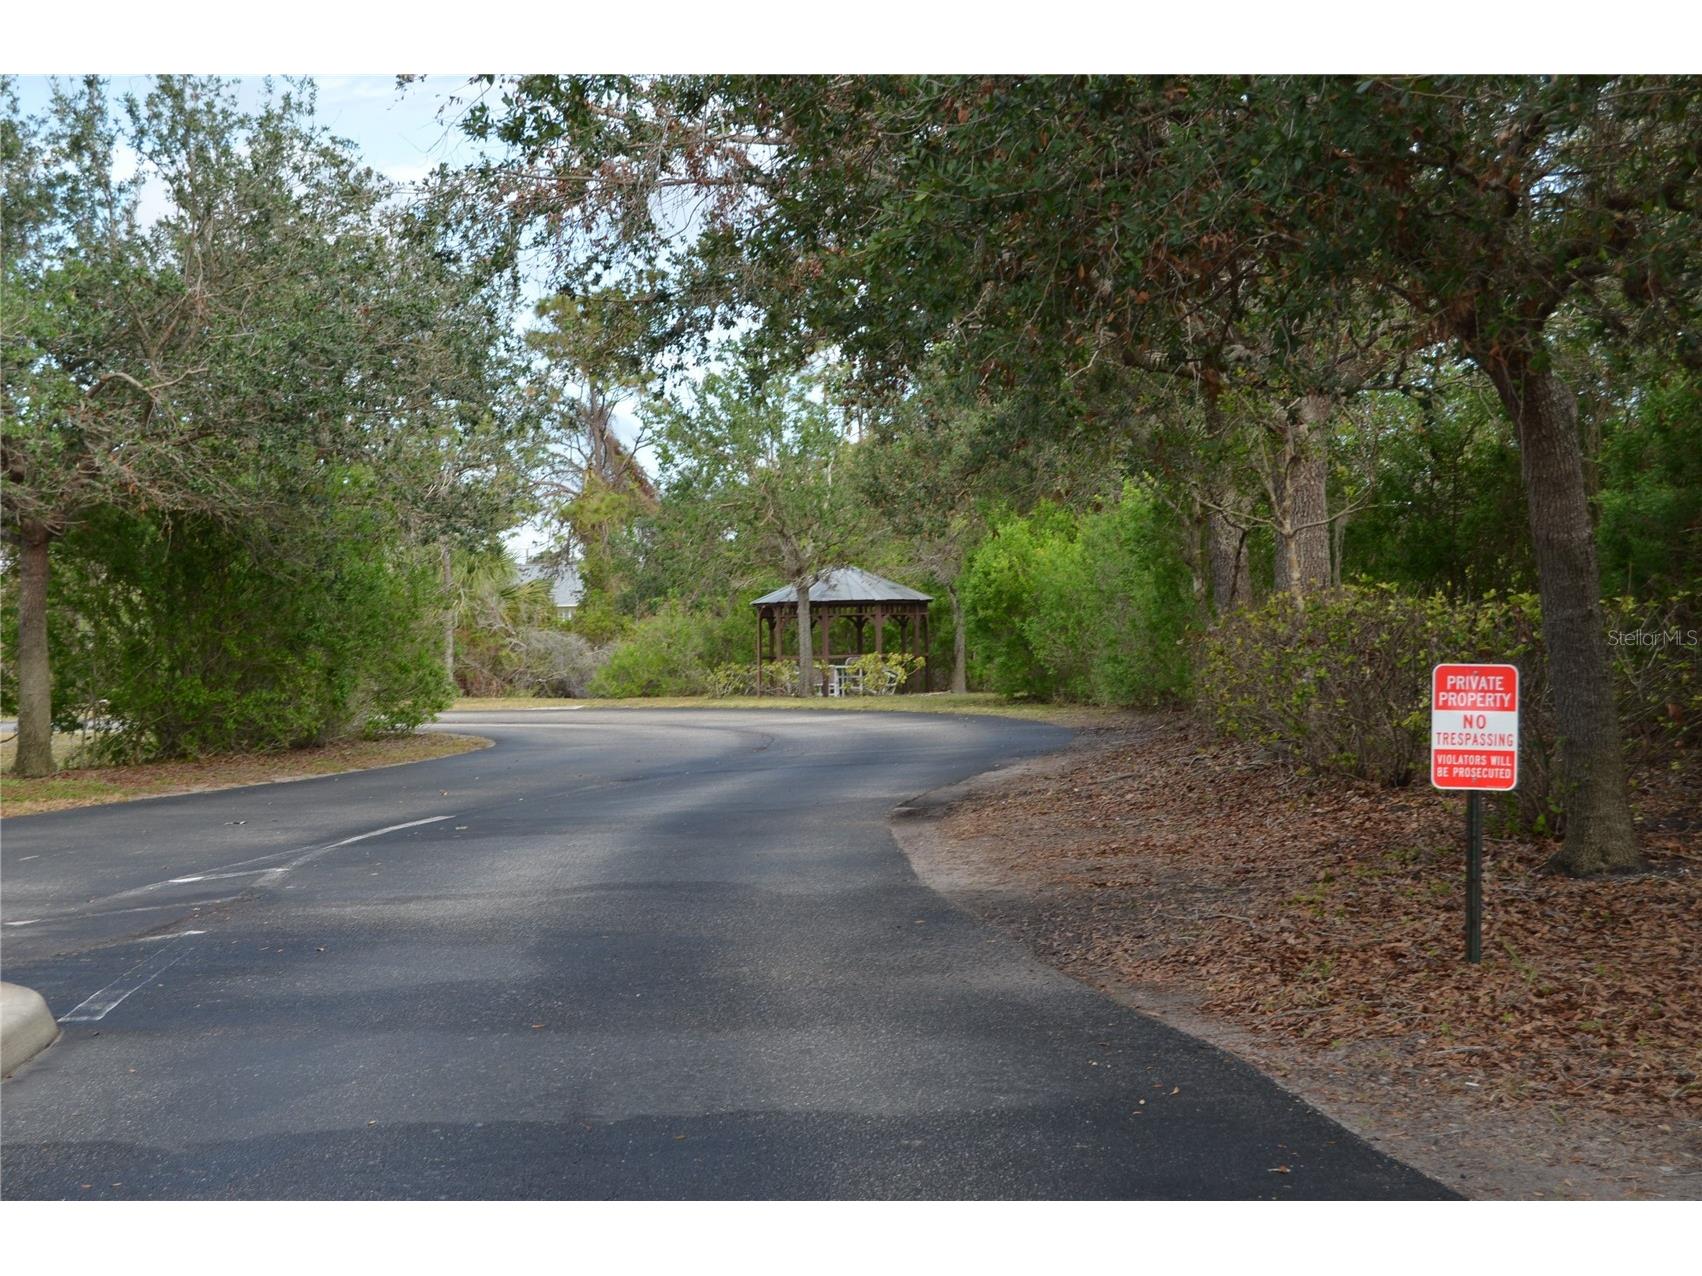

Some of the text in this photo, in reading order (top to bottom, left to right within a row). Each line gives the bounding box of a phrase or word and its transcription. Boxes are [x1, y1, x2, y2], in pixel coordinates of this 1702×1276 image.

[1447, 675, 1504, 690] PRIVATE
[1438, 692, 1511, 707] PROPERTY
[1463, 714, 1486, 729] NO
[1436, 732, 1514, 746] TRESPASSING
[1437, 754, 1512, 766] VIOLATORS WILL
[1436, 767, 1512, 778] BE PROSECUTED
